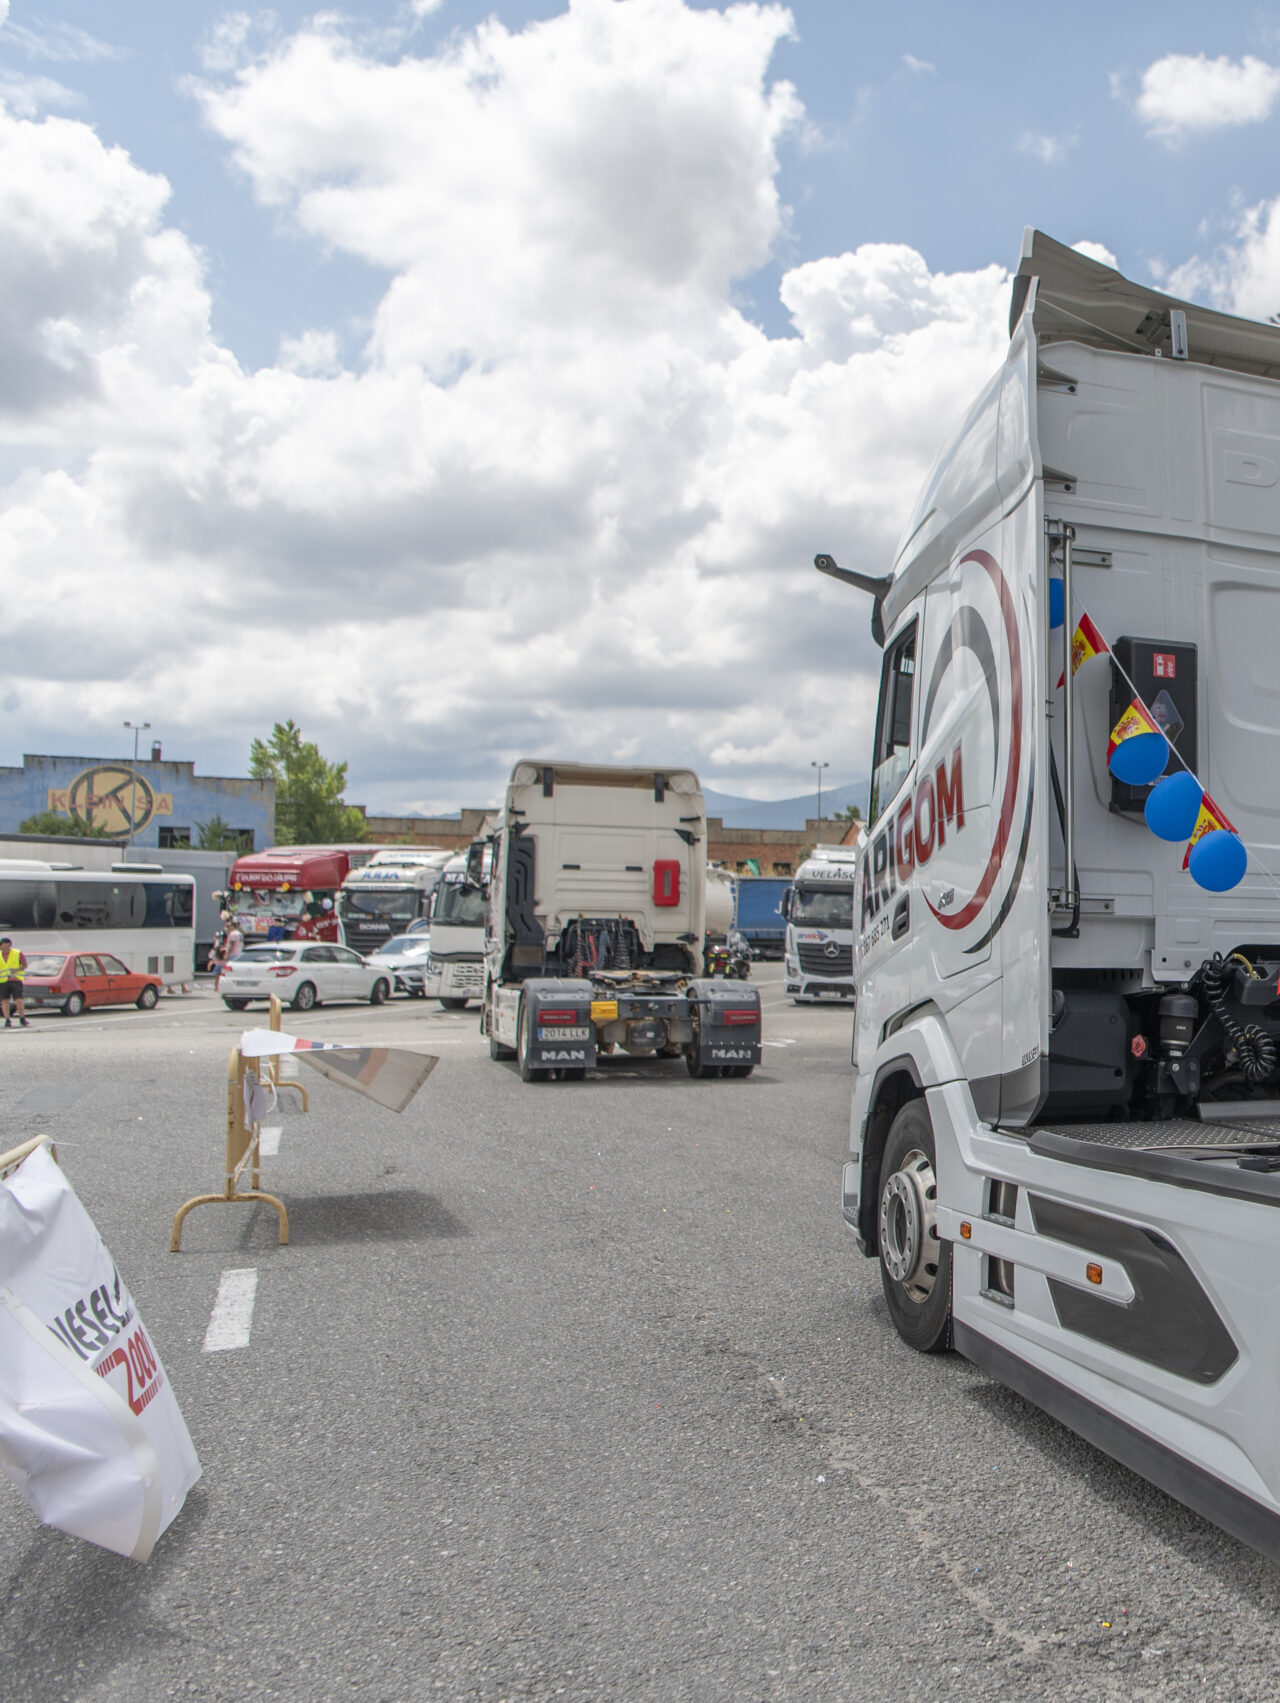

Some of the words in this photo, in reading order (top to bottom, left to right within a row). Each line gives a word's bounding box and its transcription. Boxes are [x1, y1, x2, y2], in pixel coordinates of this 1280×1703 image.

[812, 867, 856, 879] VELÁSC
[544, 1027, 568, 1038] 2014
[571, 1027, 587, 1038] LLK
[541, 1050, 585, 1060] MAN
[711, 1049, 752, 1059] MAN
